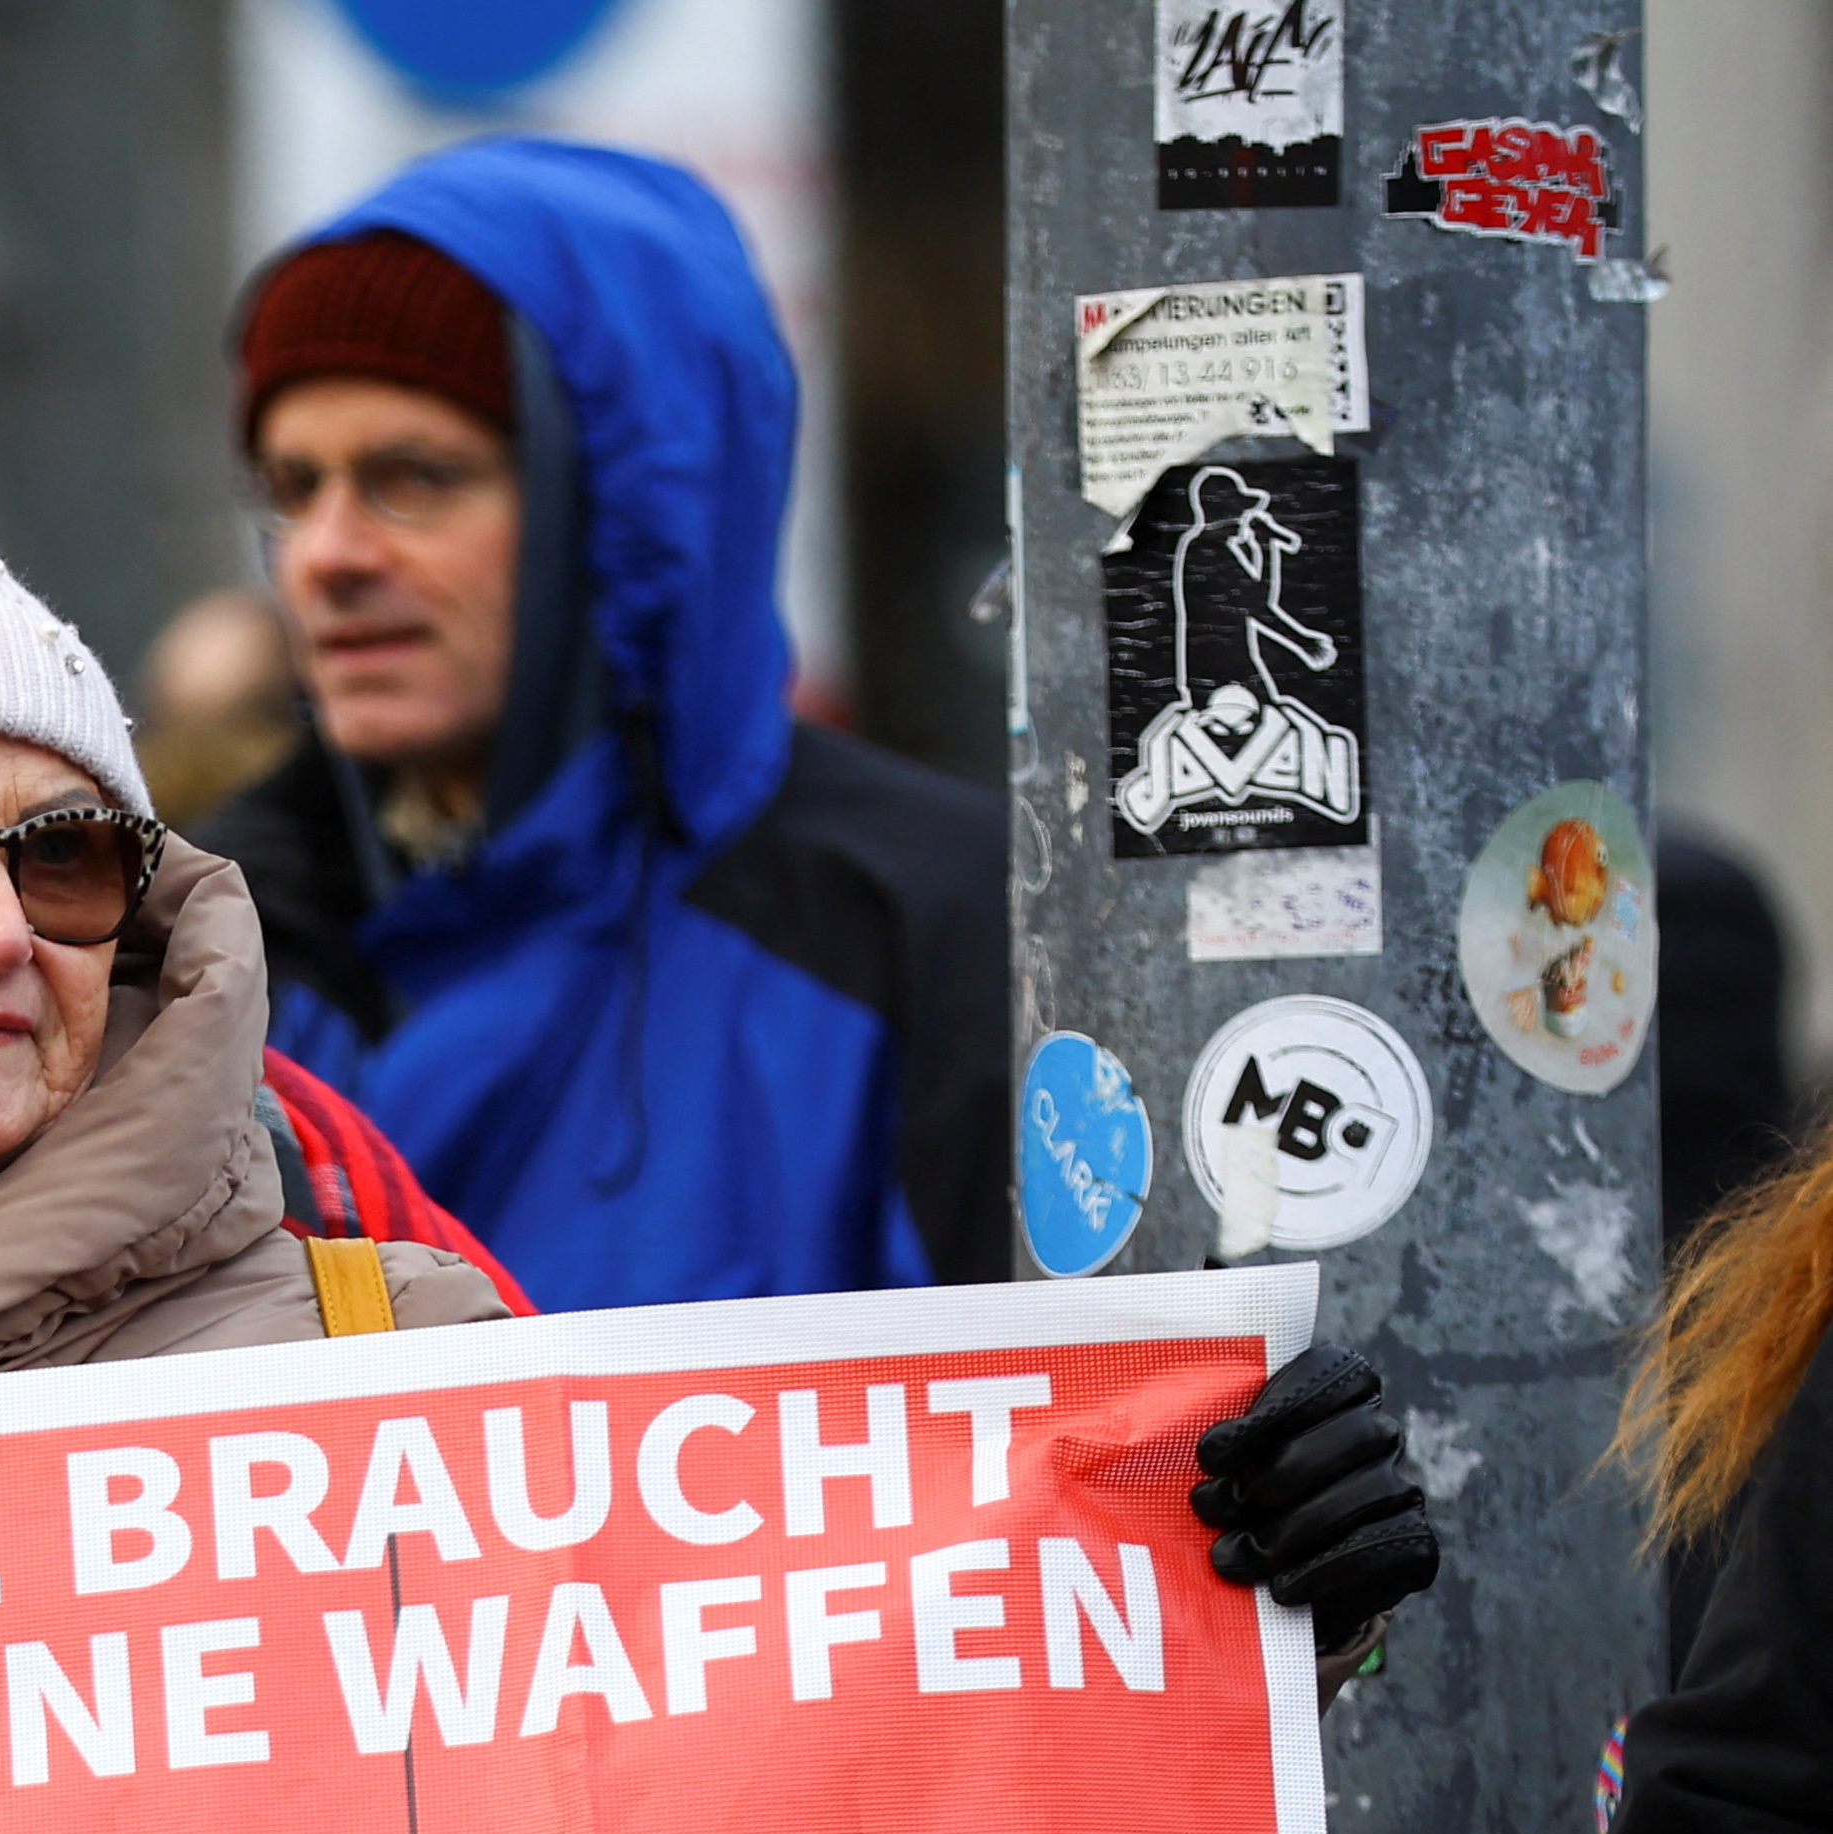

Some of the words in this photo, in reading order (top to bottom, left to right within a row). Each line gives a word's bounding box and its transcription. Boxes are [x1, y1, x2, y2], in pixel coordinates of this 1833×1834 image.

[1196, 358, 1234, 384] 44
[1180, 805, 1295, 832] jovensounds
[66, 1373, 1054, 1598] BRAUCHT
[322, 1535, 1168, 1749] WAFFEN
